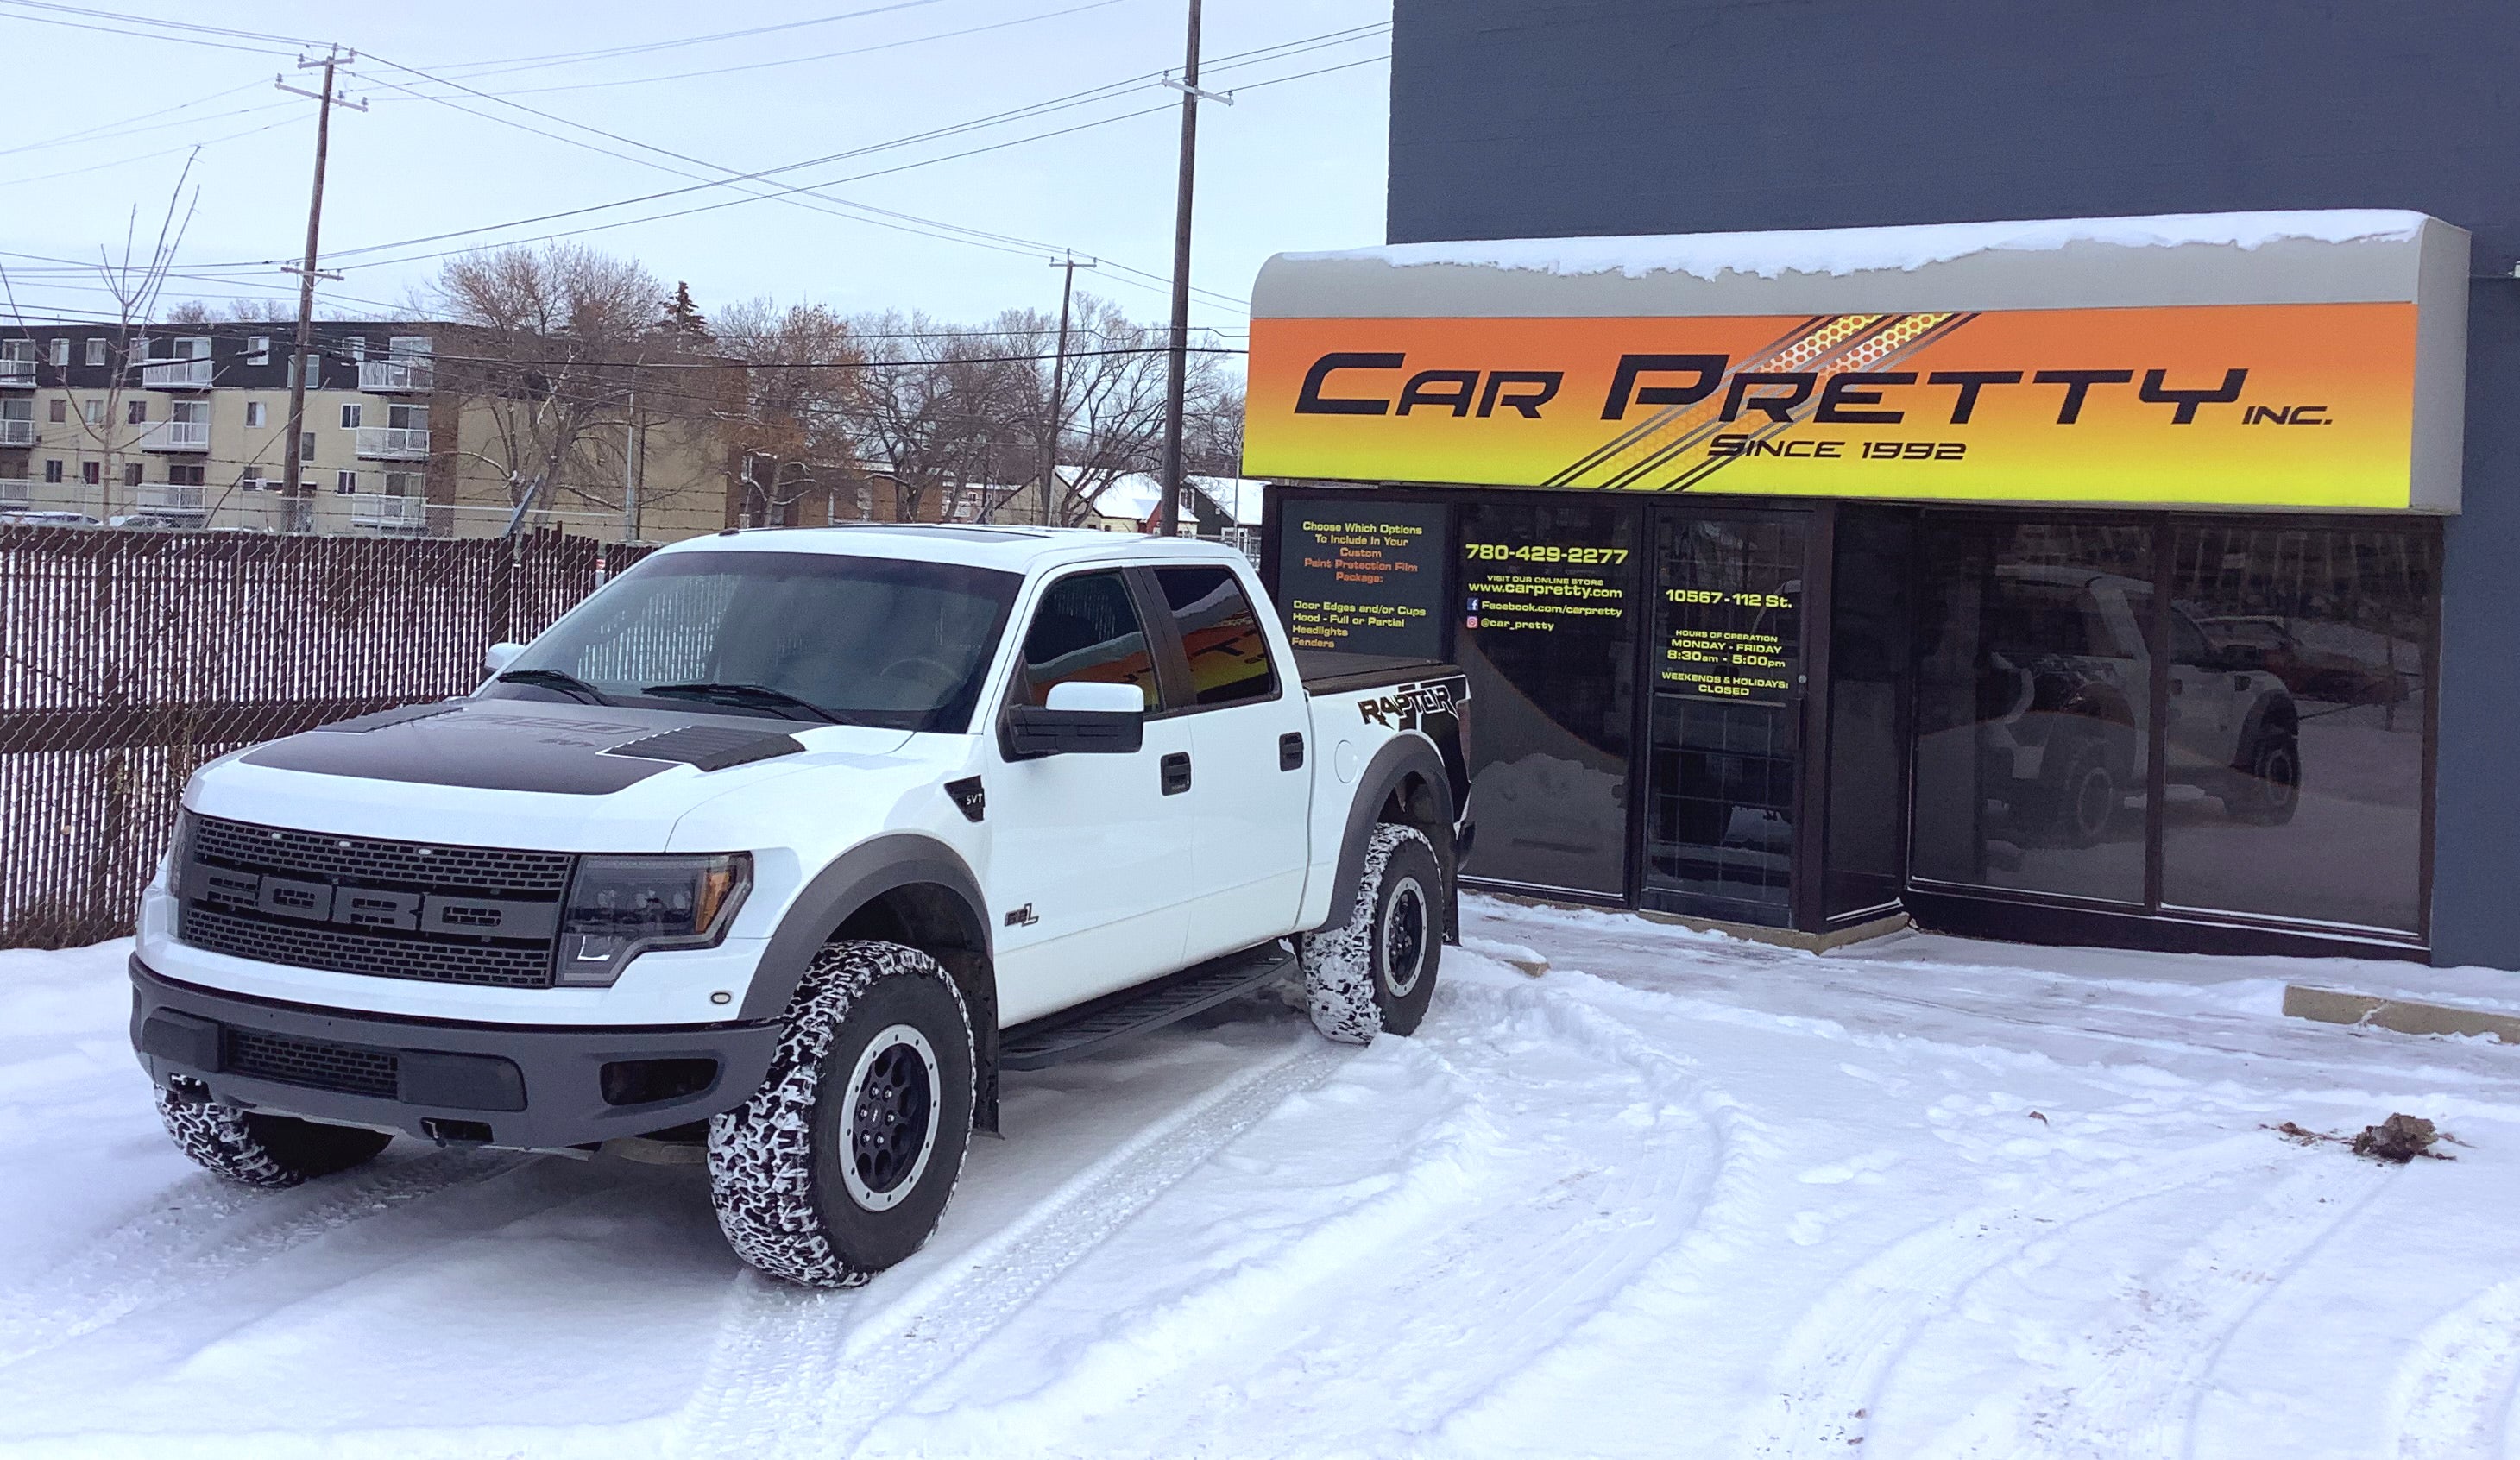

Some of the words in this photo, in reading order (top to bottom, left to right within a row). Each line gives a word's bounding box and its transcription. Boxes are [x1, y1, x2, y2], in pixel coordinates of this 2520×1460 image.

[1294, 352, 1565, 420] CAR
[1600, 353, 2248, 425] PRETTY
[2242, 406, 2333, 425] INC.
[1708, 435, 1847, 458] SINCE
[1862, 441, 1967, 461] 1992
[1303, 521, 1341, 532] Choose
[1345, 523, 1377, 532] Which
[1380, 525, 1423, 535] Options
[1315, 533, 1328, 544] To
[1331, 534, 1368, 545] Include
[1370, 536, 1380, 545] In
[1383, 537, 1409, 547] Your
[1339, 547, 1382, 558] Custom
[1465, 544, 1629, 564] 780-429-2277
[1304, 557, 1332, 569] Paint
[1335, 559, 1392, 571] Protection
[1395, 562, 1418, 573] Film
[1335, 571, 1383, 584] Package:
[1534, 576, 1569, 585] ONLINE
[1468, 582, 1622, 599] www.carpretty.com
[1293, 600, 1320, 610] Door
[1323, 601, 1356, 613] Edges
[1358, 604, 1395, 614] and/or
[1397, 606, 1427, 617] Cups
[1766, 595, 1792, 608] St.
[1482, 601, 1622, 617] Facebook.com/carpretty
[1293, 612, 1320, 623] Hood
[1329, 614, 1349, 625] Full
[1368, 616, 1405, 627] Partial
[1480, 618, 1554, 632] @car_pretty
[1292, 625, 1348, 637] Headlights
[1676, 630, 1708, 639] HOURS
[1724, 632, 1778, 643] OPERATION
[1292, 637, 1335, 648] Fenders
[1671, 639, 1726, 650] MONDAY
[1736, 644, 1782, 654] FRIDAY
[1667, 650, 1718, 663] 8:30am
[1732, 654, 1786, 668] 5:00pm
[1662, 671, 1721, 683] WEEKENDS
[1698, 684, 1749, 695] CLOSED
[1358, 685, 1459, 730] RAPTOR
[966, 793, 983, 805] SVT
[179, 864, 559, 939] FORD
